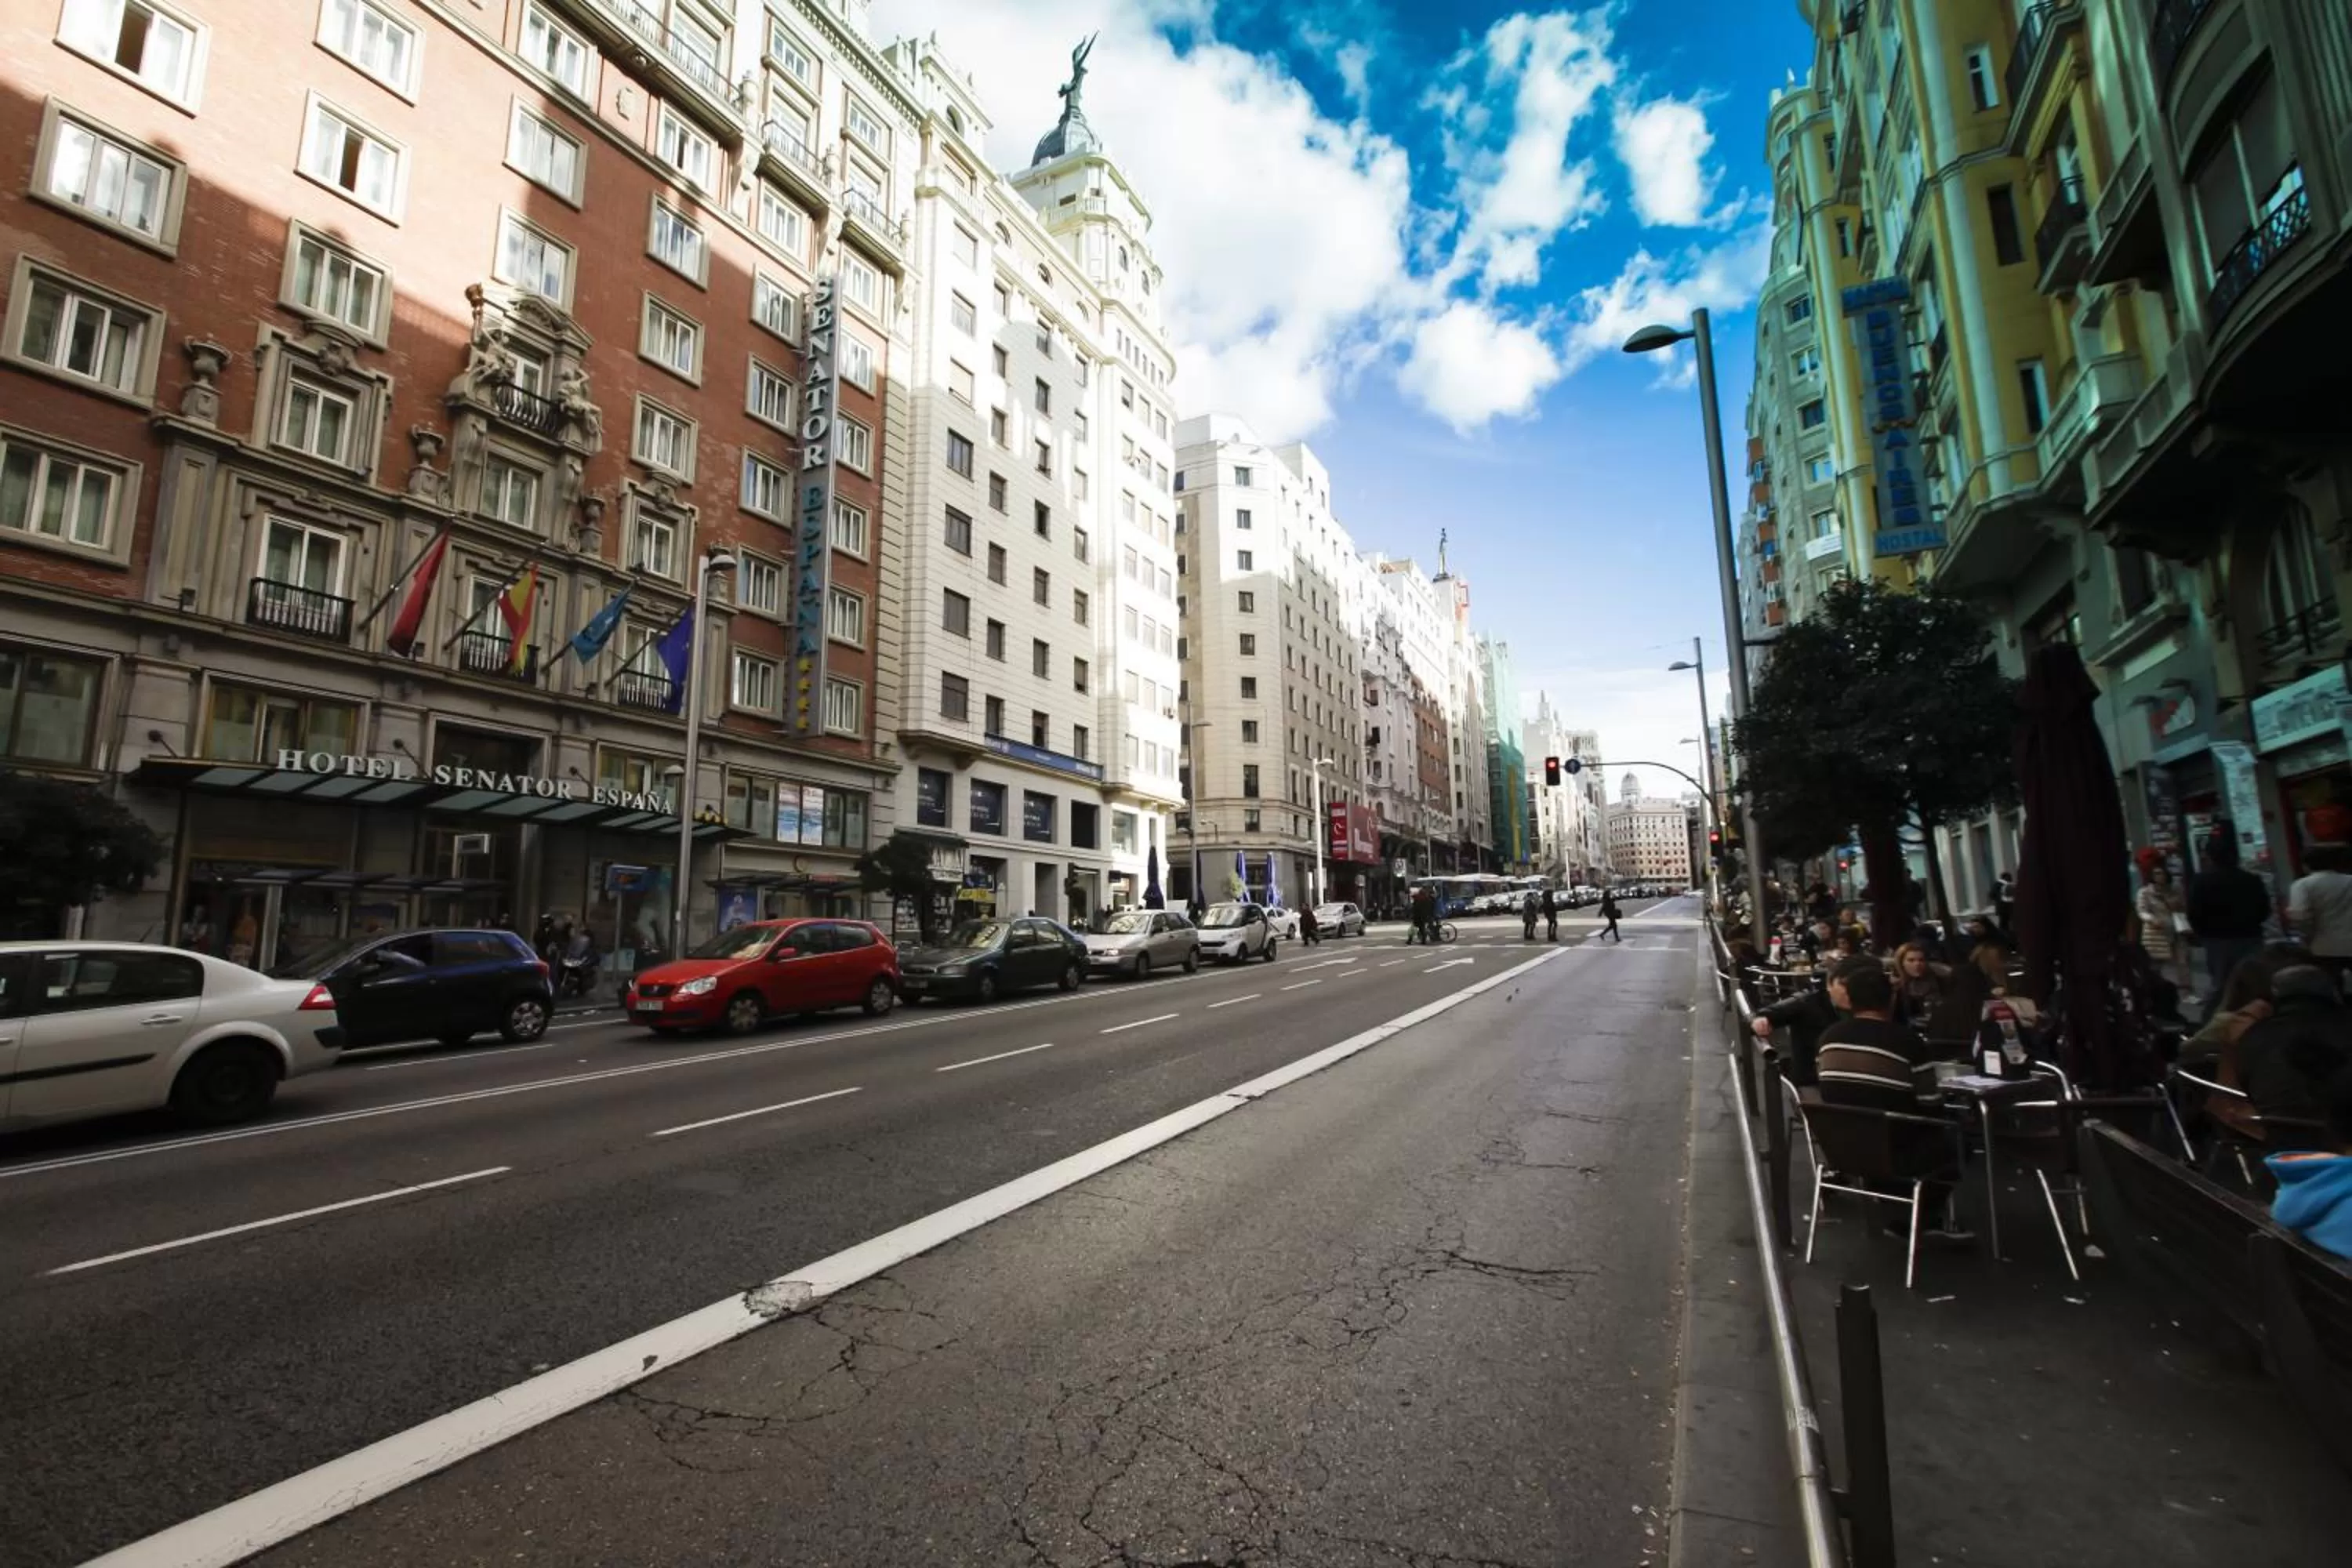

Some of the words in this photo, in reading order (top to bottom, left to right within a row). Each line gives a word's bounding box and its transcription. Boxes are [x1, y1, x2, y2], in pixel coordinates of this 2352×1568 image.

[802, 277, 833, 470] SENATOR
[1878, 528, 1942, 552] HOSTAL
[276, 749, 415, 781] HOTEL
[434, 764, 573, 800] SENATOR
[592, 786, 672, 815] ESPAÑA
